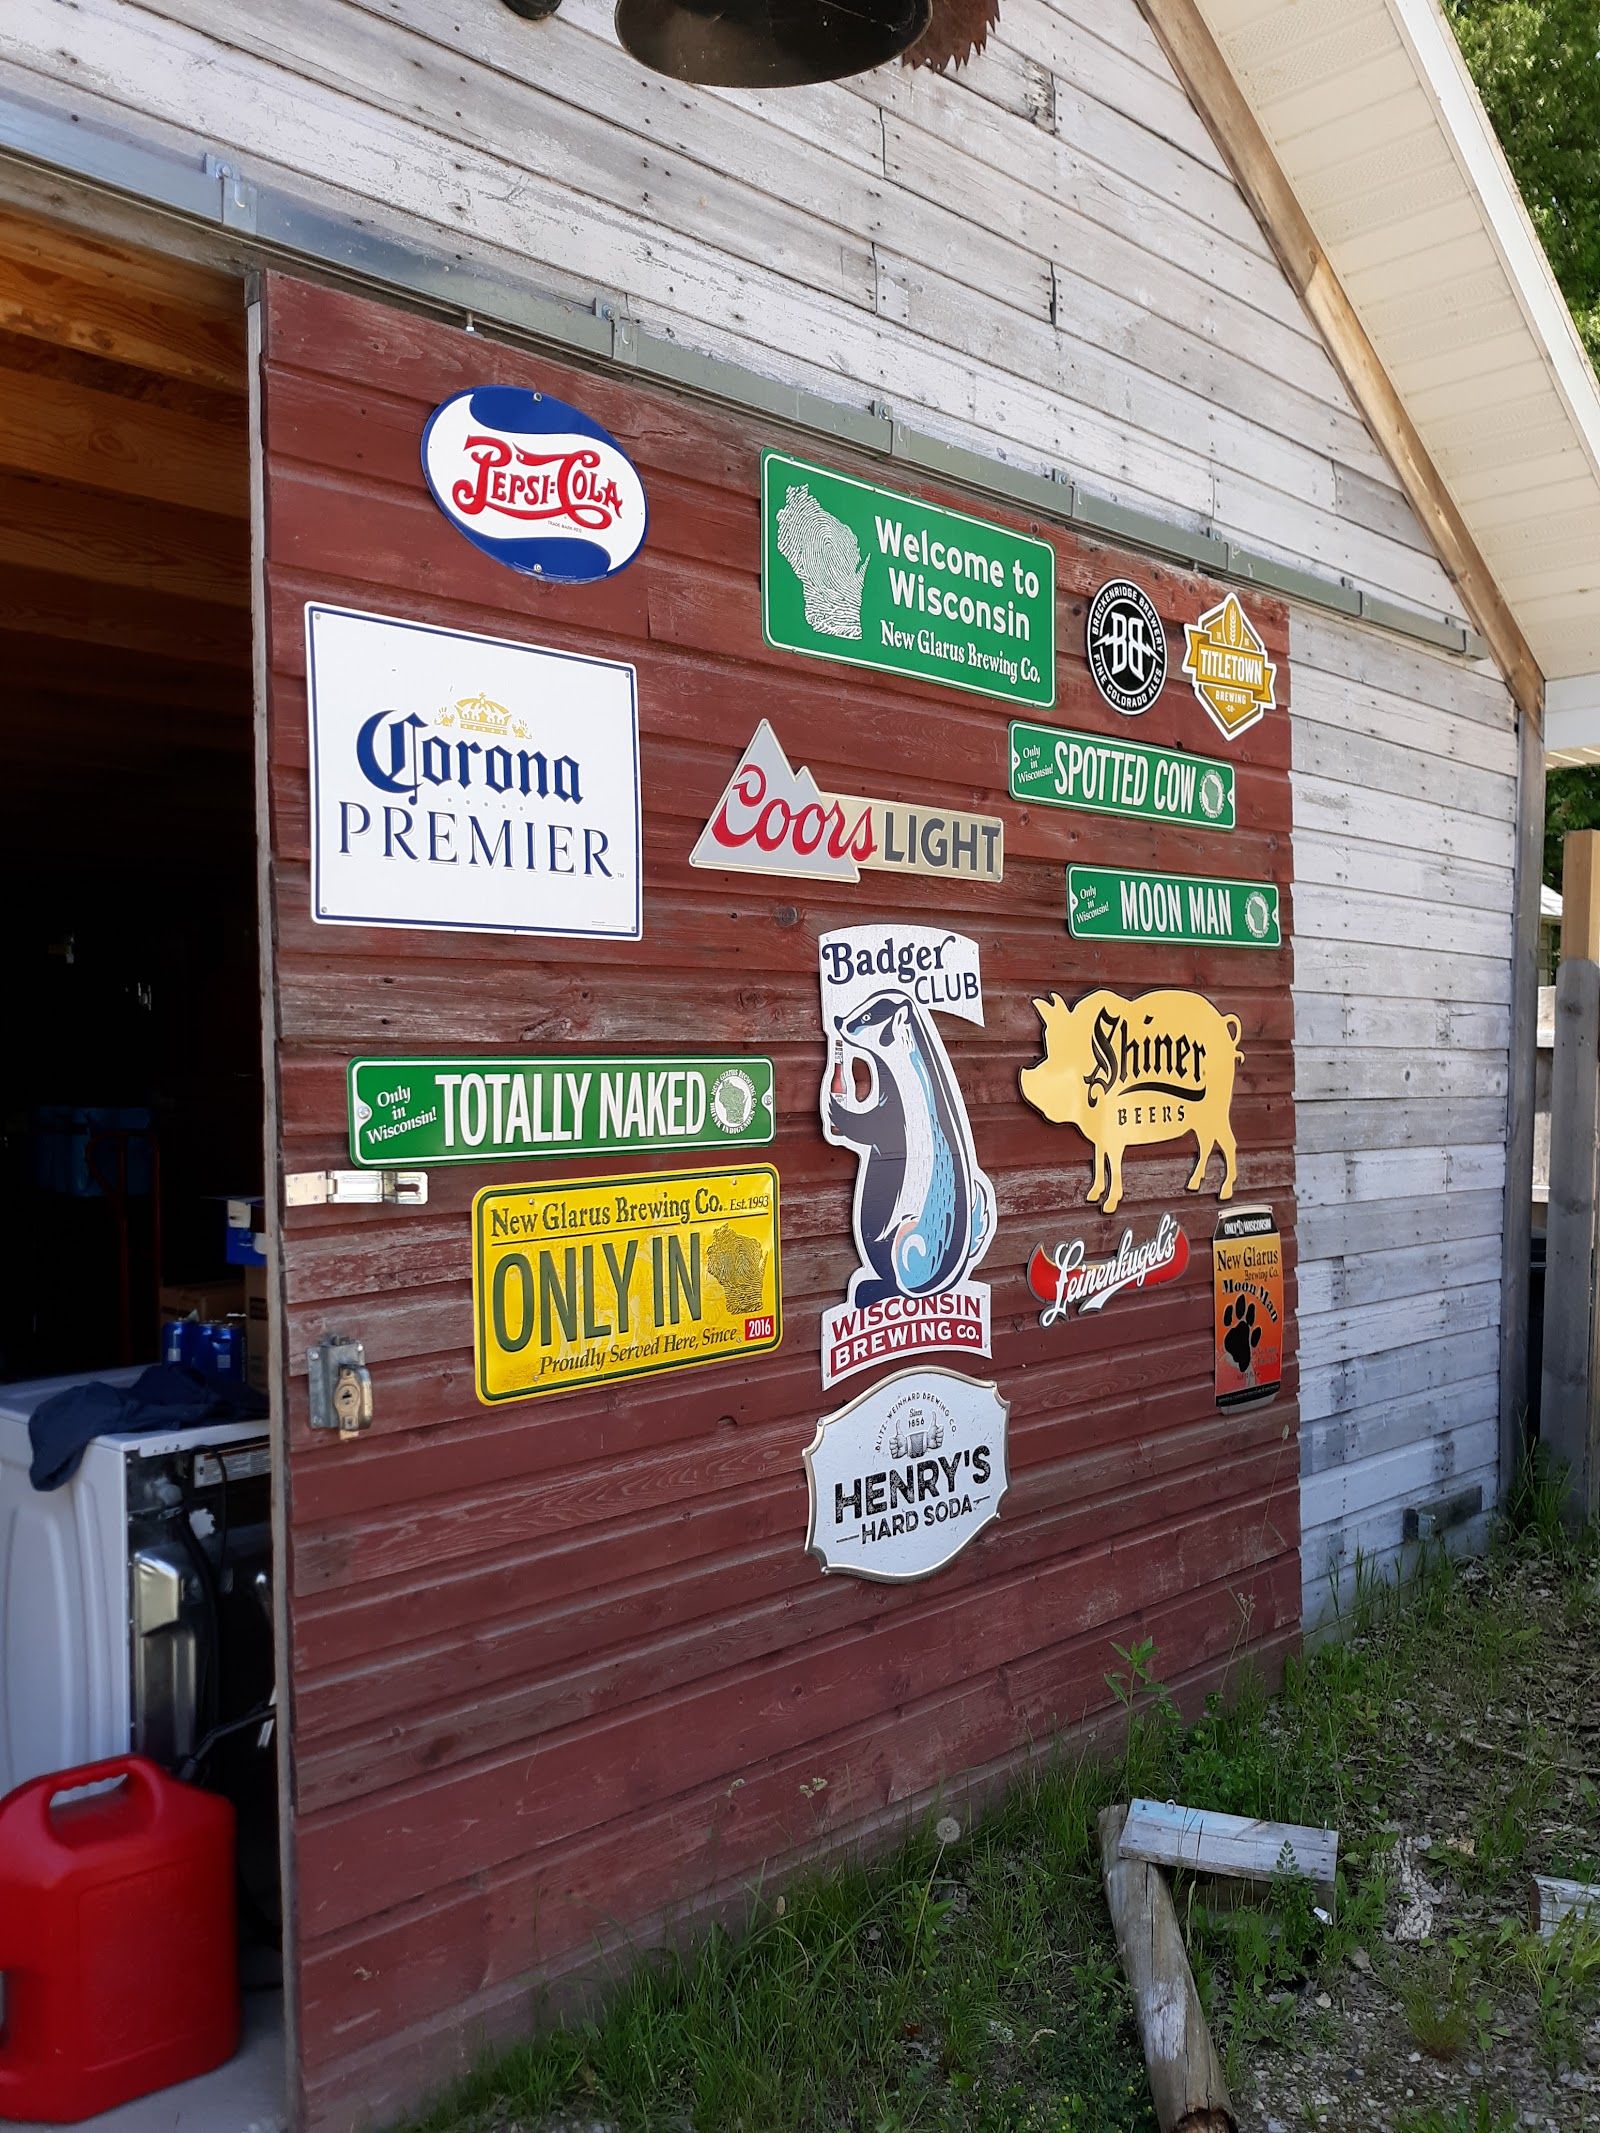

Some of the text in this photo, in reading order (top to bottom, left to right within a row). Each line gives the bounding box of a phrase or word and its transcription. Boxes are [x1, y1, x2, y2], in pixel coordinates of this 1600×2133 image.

[874, 515, 1040, 598] Welcome to
[888, 566, 1030, 641] Wisconsin
[1092, 586, 1164, 653] BRECKENRIDGE BREWERY
[880, 619, 1041, 684] New Glarus Brewing Co.
[1200, 649, 1263, 686] TITLETOWN
[1093, 654, 1163, 708] FINE COLORADO ALES
[1215, 689, 1247, 705] BREWING
[356, 709, 584, 806] Corona
[1022, 745, 1041, 759] Only
[1030, 758, 1038, 769] in
[1053, 741, 1149, 807] SPOTTED
[1153, 759, 1197, 814] COW
[338, 801, 615, 879] PREMIER
[711, 764, 1001, 873] Coors LIGHT
[1080, 885, 1097, 899] Only
[1087, 898, 1095, 909] in
[1119, 880, 1183, 933] MOON
[1188, 886, 1233, 935] MAN
[821, 935, 956, 985] Badger
[914, 971, 980, 1005] CLUB
[1083, 1005, 1207, 1108] Shiner
[377, 1085, 411, 1107] Only
[391, 1105, 407, 1120] in
[435, 1070, 707, 1147] TOTALLY NAKED
[1117, 1105, 1185, 1126] BEERS
[366, 1106, 437, 1144] Wisconsin!
[491, 1207, 539, 1238] New
[542, 1201, 610, 1231] Glarus
[615, 1191, 691, 1225] Brewing
[695, 1188, 723, 1214] Co.
[748, 1195, 769, 1209] 1993
[1243, 1218, 1272, 1233] WISCONSIN
[1042, 1214, 1178, 1327] Leinenkugel's
[1216, 1246, 1279, 1272] New Glarus
[1244, 1268, 1268, 1282] Brewing
[493, 1232, 702, 1353] ONLY IN
[831, 1293, 982, 1342] WISCONSIN
[1222, 1279, 1278, 1323] Moon Man
[538, 1318, 771, 1376] Proudly Served Here, Since 2016
[835, 1321, 980, 1372] BREWING CO.
[908, 1417, 925, 1428] 1856
[922, 1392, 950, 1417] BREWING
[834, 1445, 991, 1524] HENRY'S
[861, 1493, 973, 1545] HARD SODA
